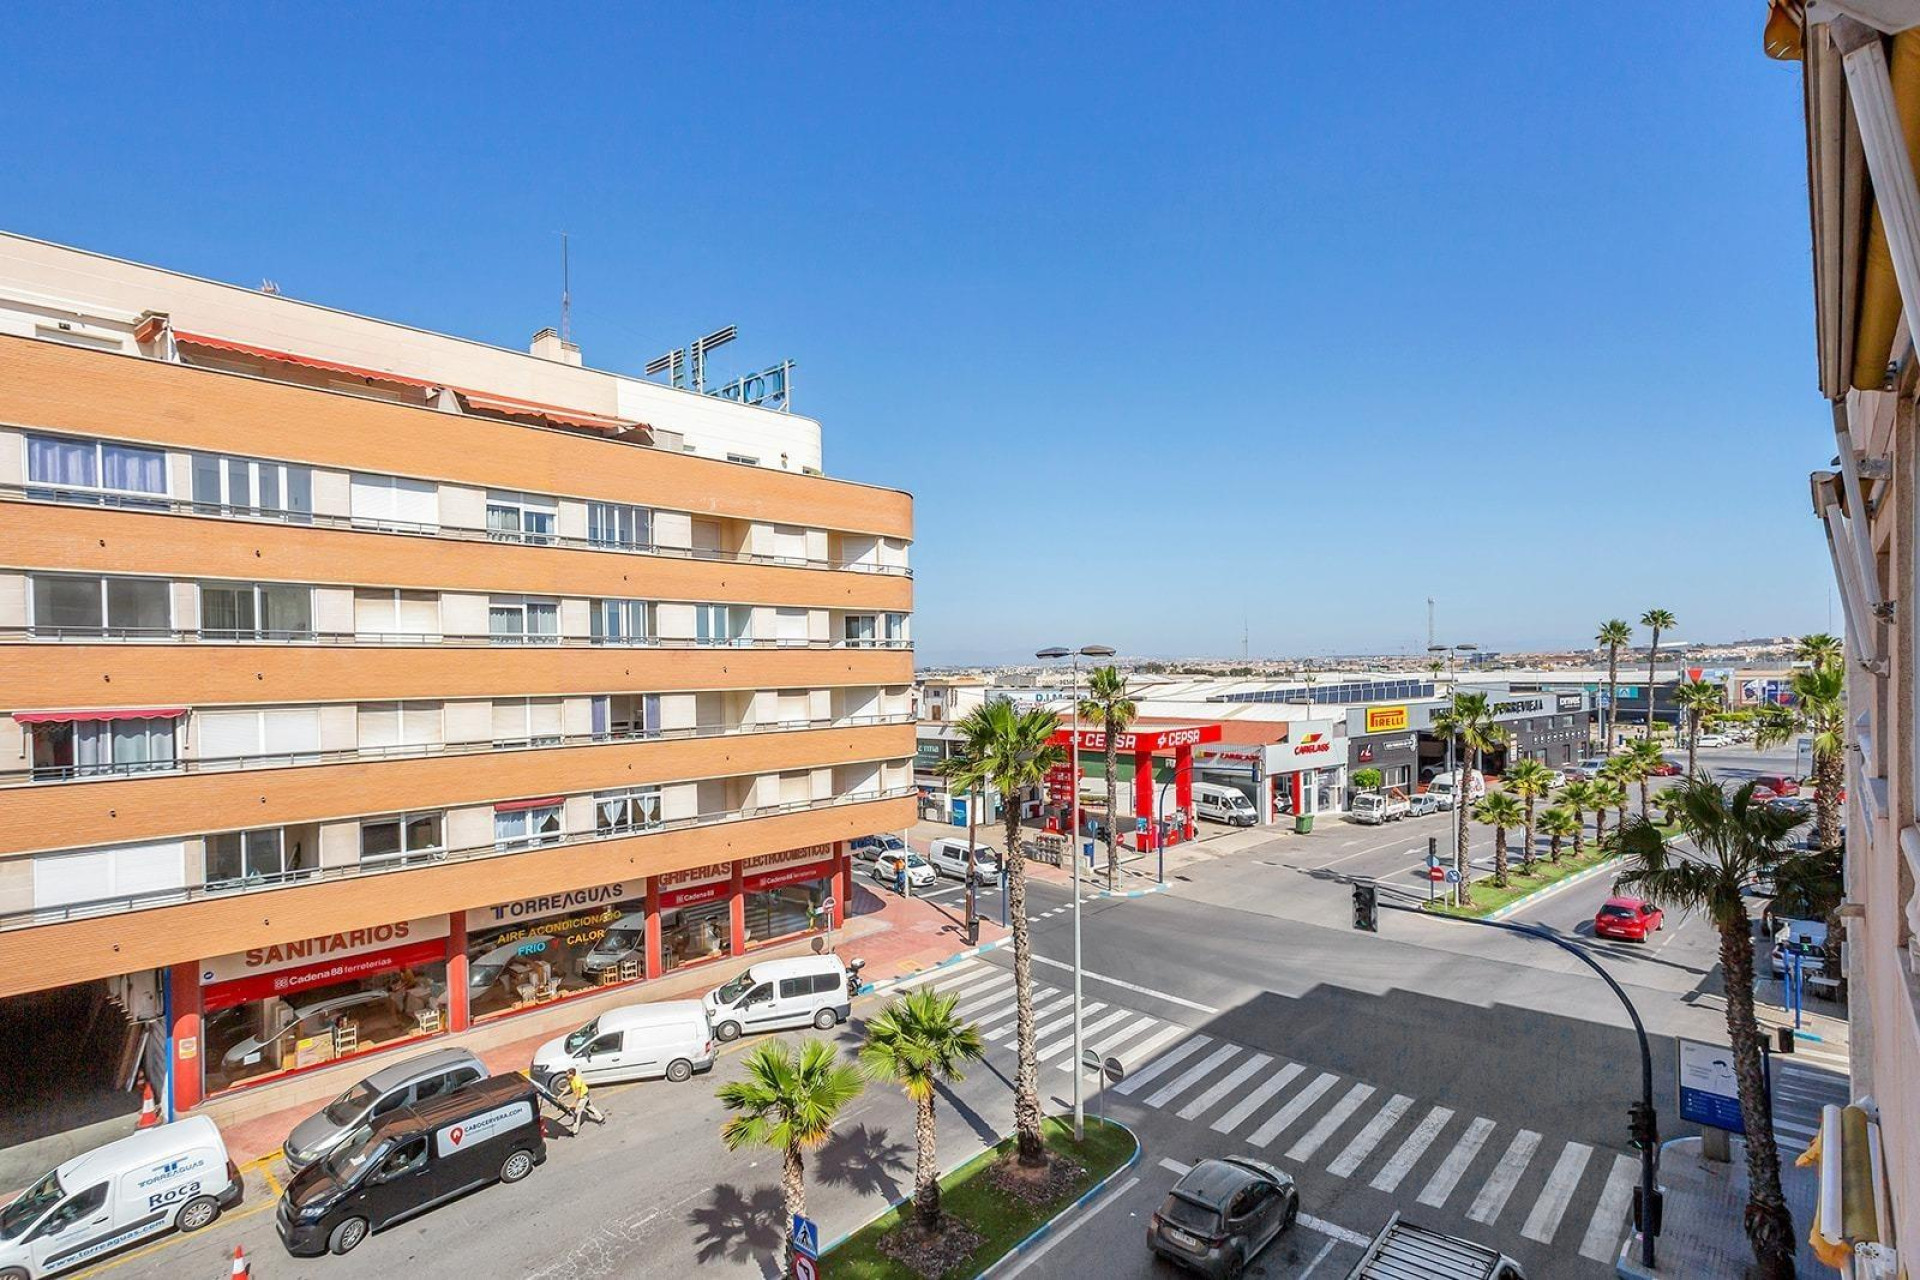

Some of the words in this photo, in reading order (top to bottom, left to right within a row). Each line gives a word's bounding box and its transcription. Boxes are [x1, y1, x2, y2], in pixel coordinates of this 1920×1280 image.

[1370, 709, 1404, 727] PIRELLI
[1085, 733, 1136, 748] CESA
[1168, 729, 1200, 746] CEPSA
[490, 883, 623, 920] TORREAGUAS
[497, 929, 526, 945] AIRE
[528, 909, 622, 938] ACONDICIONADO
[566, 928, 605, 946] CALOR
[245, 920, 409, 968] SANITARIOS
[517, 941, 546, 957] FRIO
[137, 1159, 204, 1189] TORREAGUAS
[148, 1180, 201, 1208] Roca
[45, 1218, 166, 1270] www.torreaguas.com
